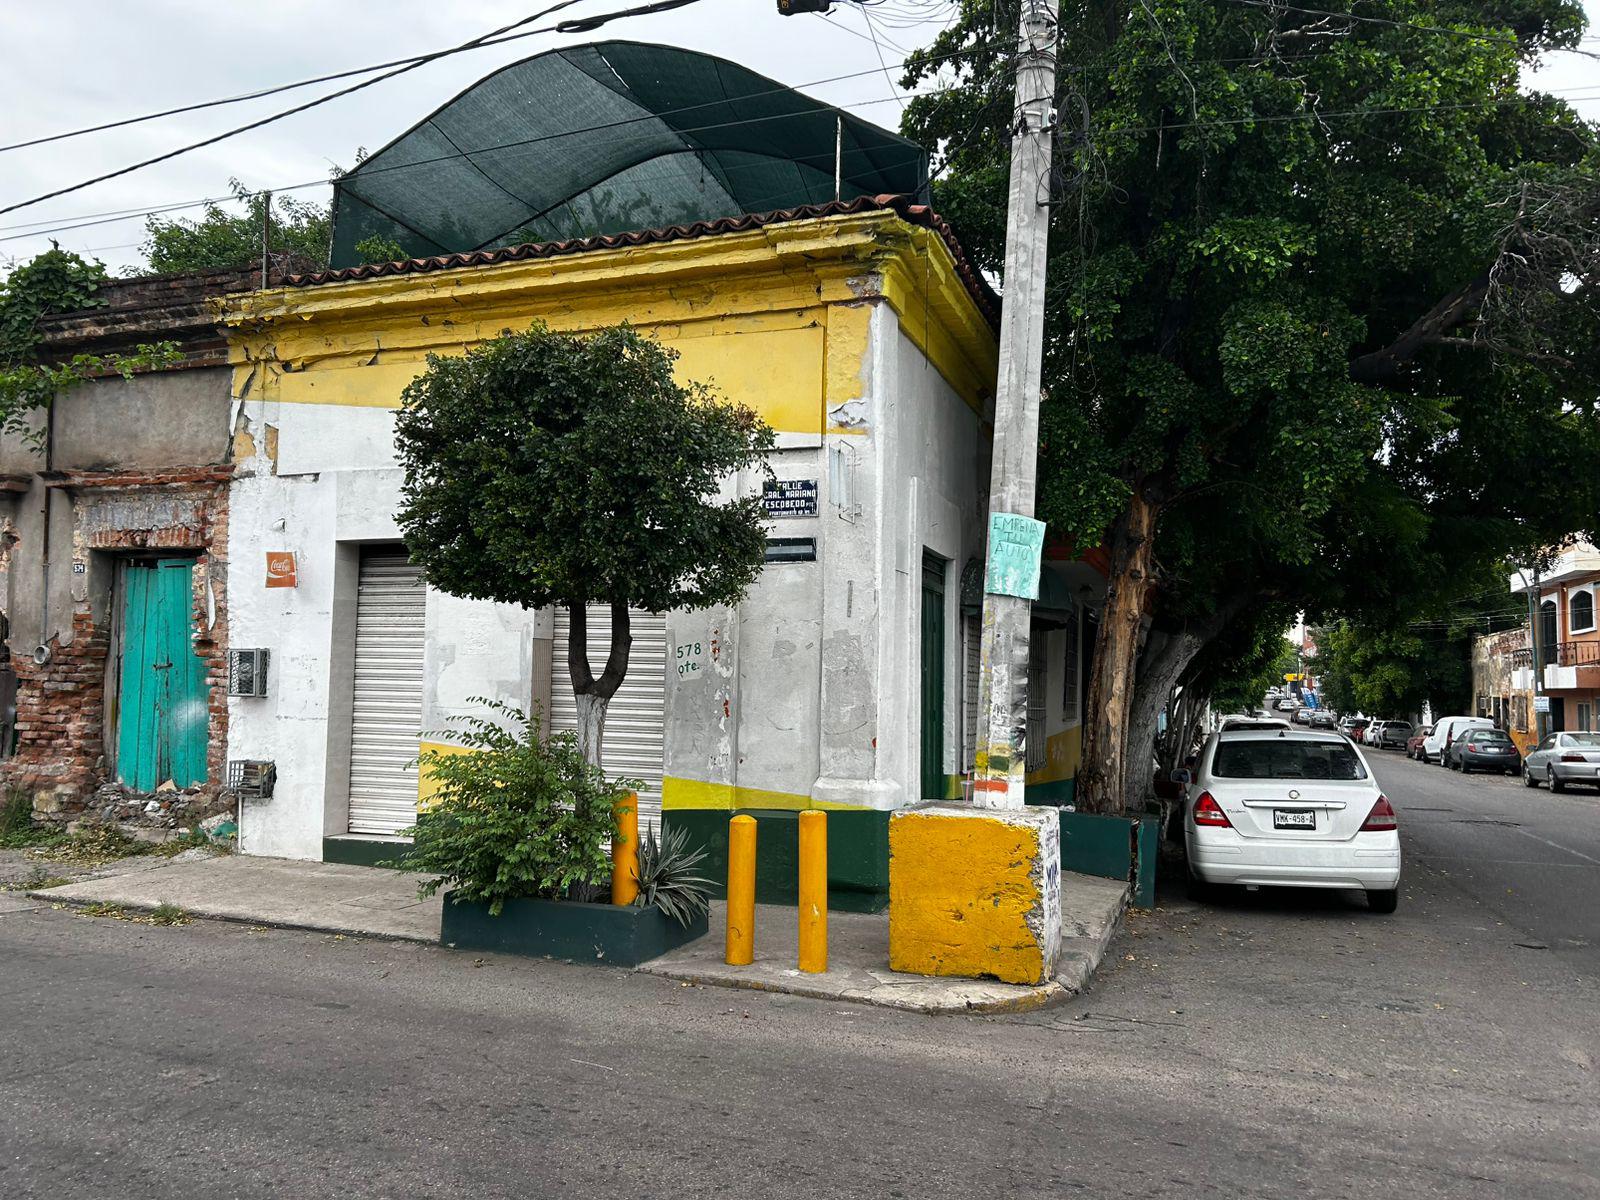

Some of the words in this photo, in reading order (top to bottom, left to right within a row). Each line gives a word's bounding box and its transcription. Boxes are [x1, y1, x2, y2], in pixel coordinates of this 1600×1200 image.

[785, 489, 816, 498] MARIANO
[765, 499, 806, 509] ESCOBEDO
[677, 642, 701, 659] 578
